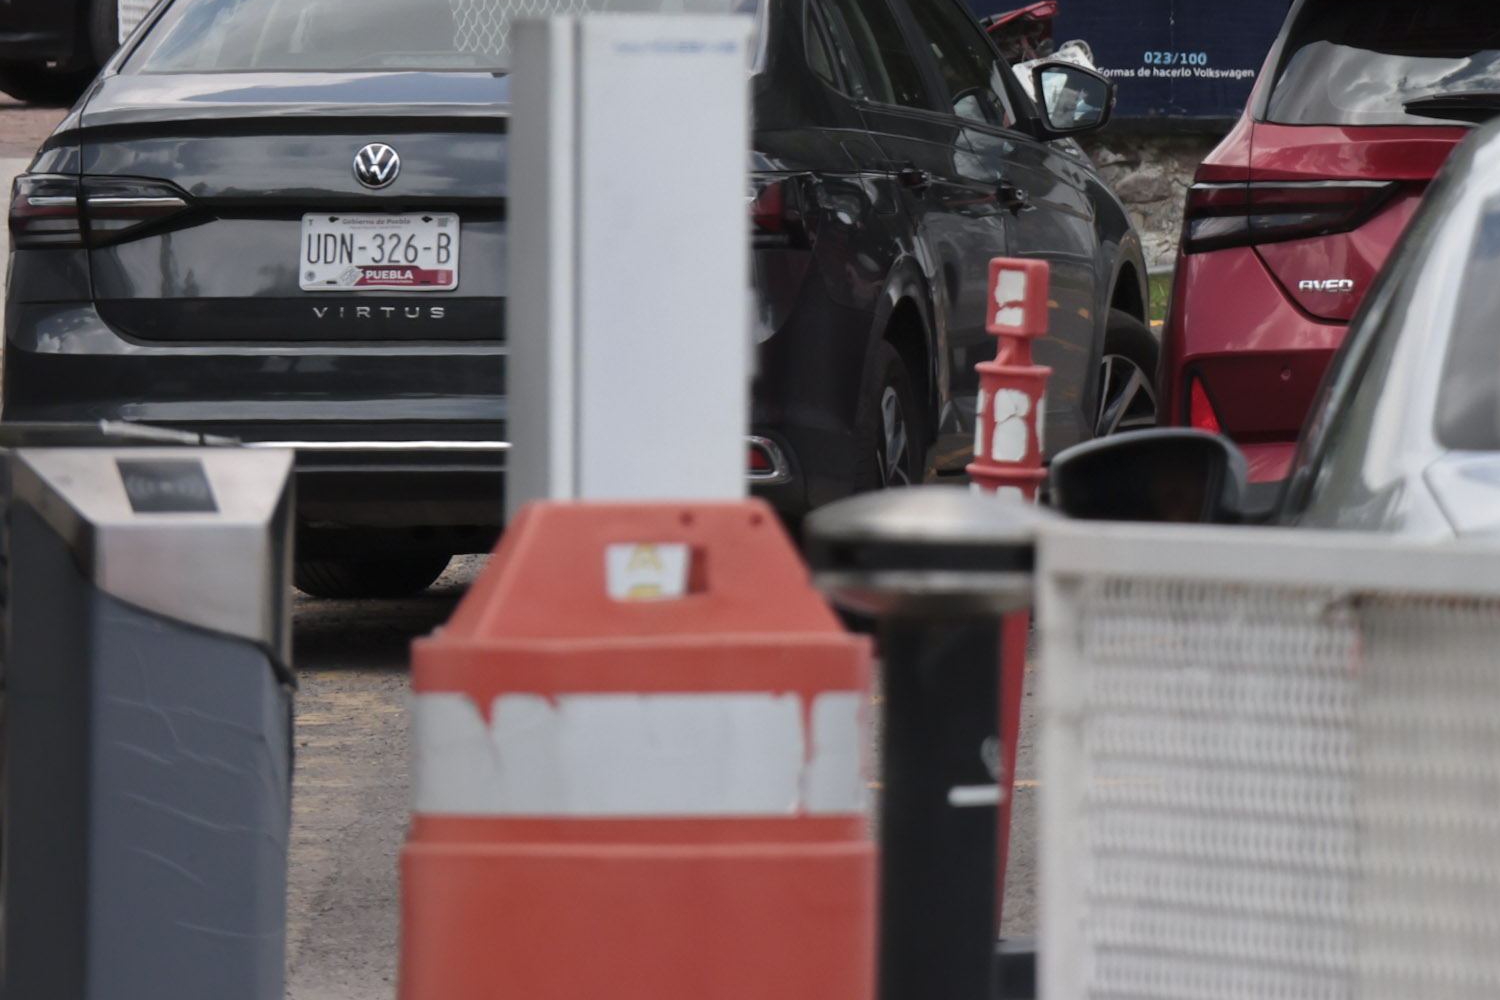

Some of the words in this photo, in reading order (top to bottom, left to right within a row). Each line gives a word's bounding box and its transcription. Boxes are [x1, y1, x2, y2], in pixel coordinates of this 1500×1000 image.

[1143, 51, 1207, 65] 023/100
[1137, 67, 1151, 78] de
[1152, 67, 1191, 78] hacerlo
[1194, 67, 1255, 80] Volkswagen
[307, 233, 452, 264] UDN-326-B
[365, 270, 414, 280] PUEBLA
[1298, 279, 1354, 293] AVEO
[313, 306, 445, 319] VIRTUS
